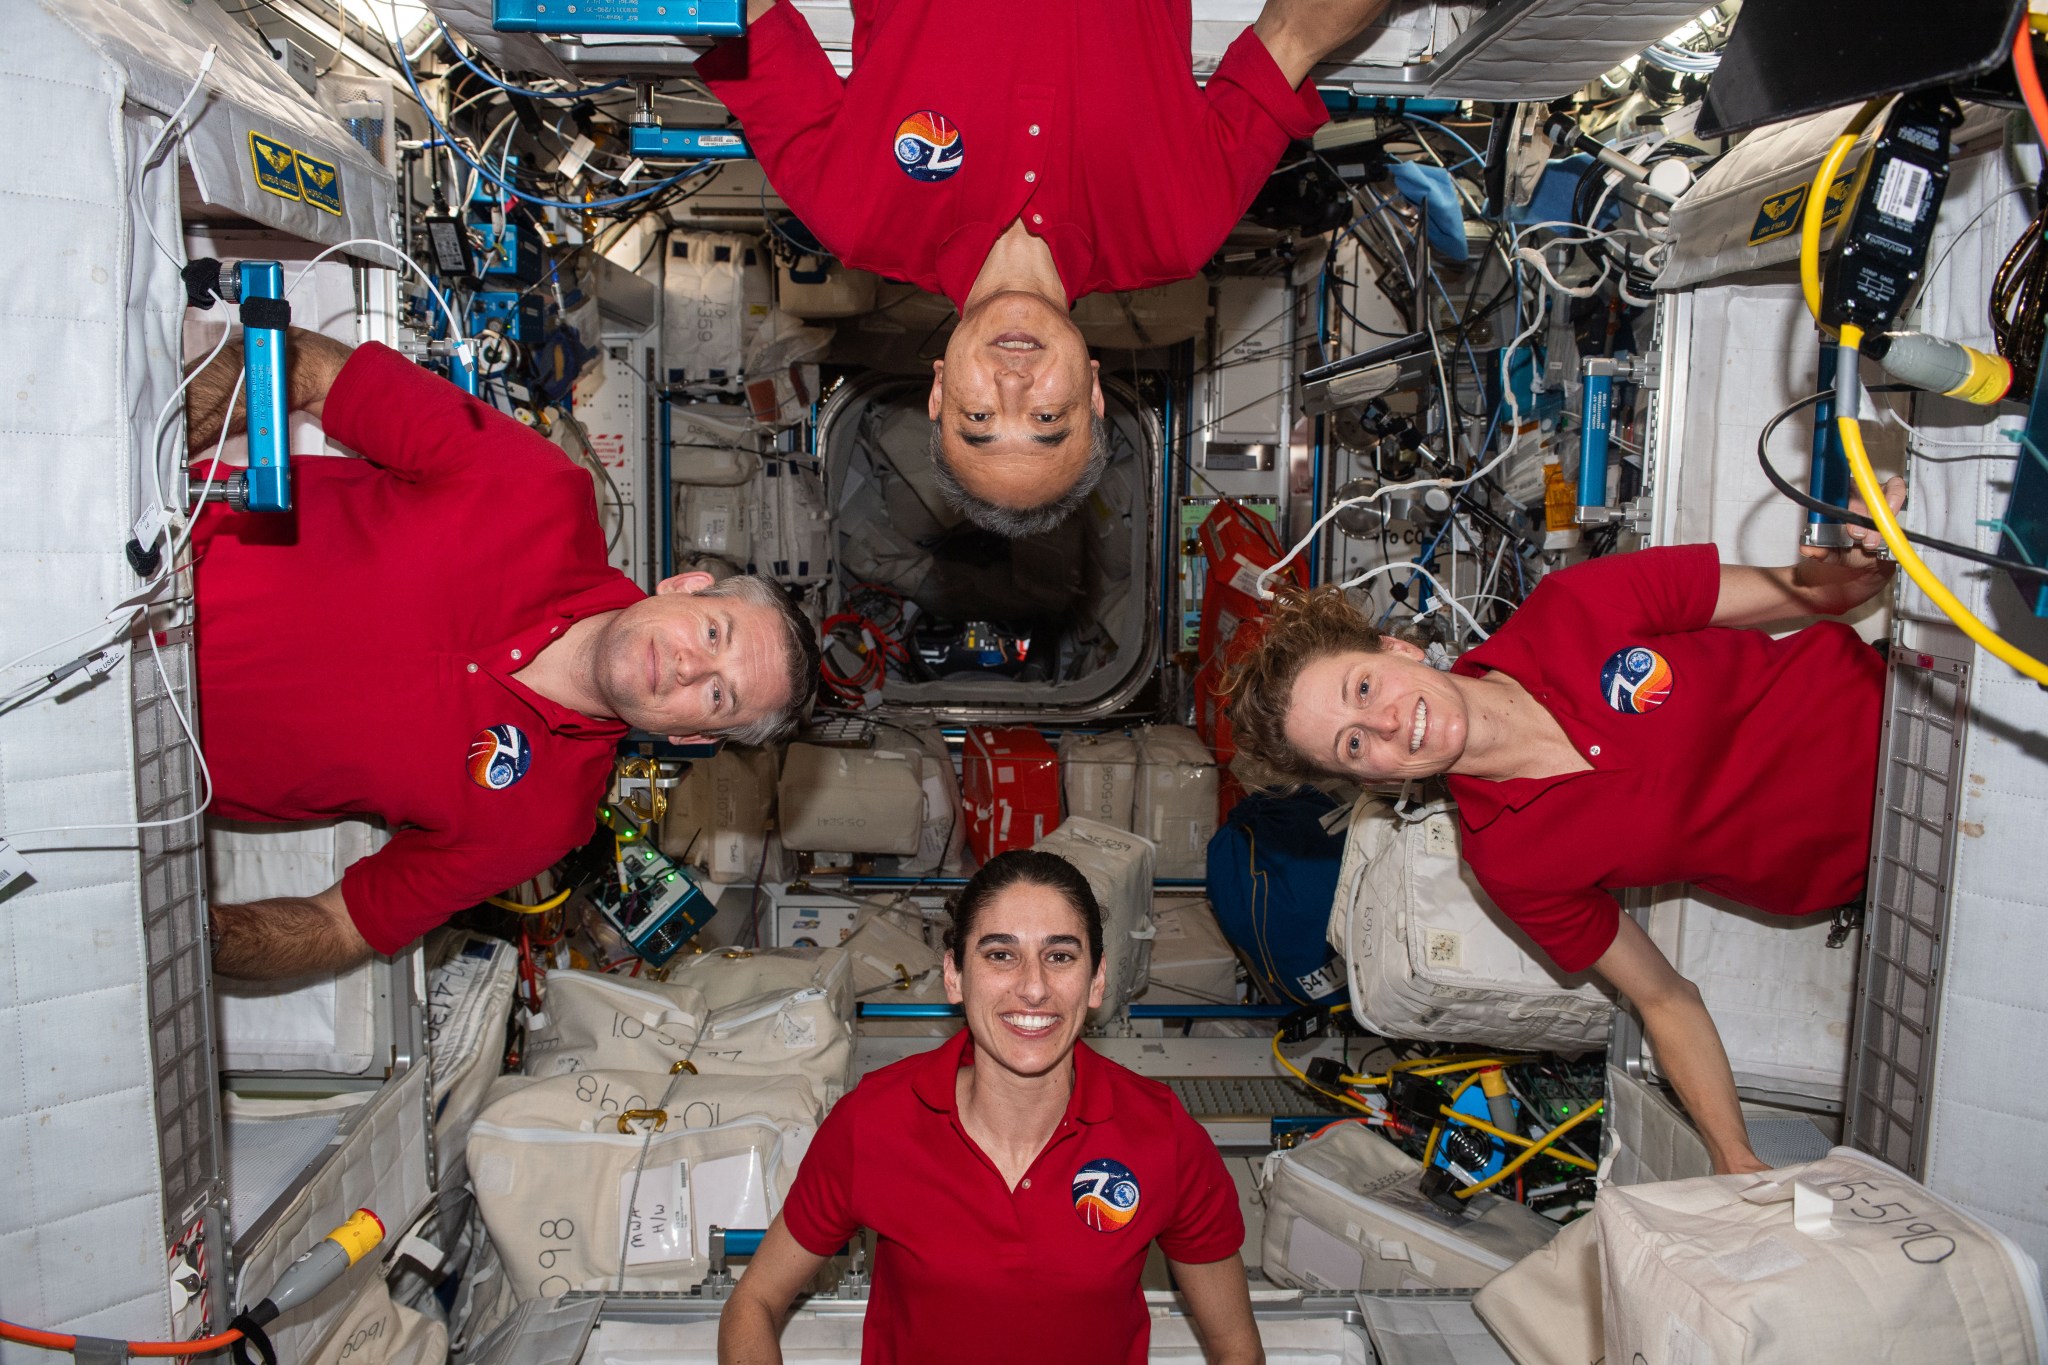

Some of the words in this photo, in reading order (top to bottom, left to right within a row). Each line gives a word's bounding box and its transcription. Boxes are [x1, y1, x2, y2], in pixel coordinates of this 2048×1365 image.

[1861, 267, 1878, 277] STRIP
[697, 294, 713, 342] 4359
[1384, 529, 1399, 544] To
[102, 652, 120, 669] USB-C
[1101, 766, 1114, 820] 10-5096
[1299, 962, 1338, 992] 5417
[649, 1203, 667, 1233] H/W
